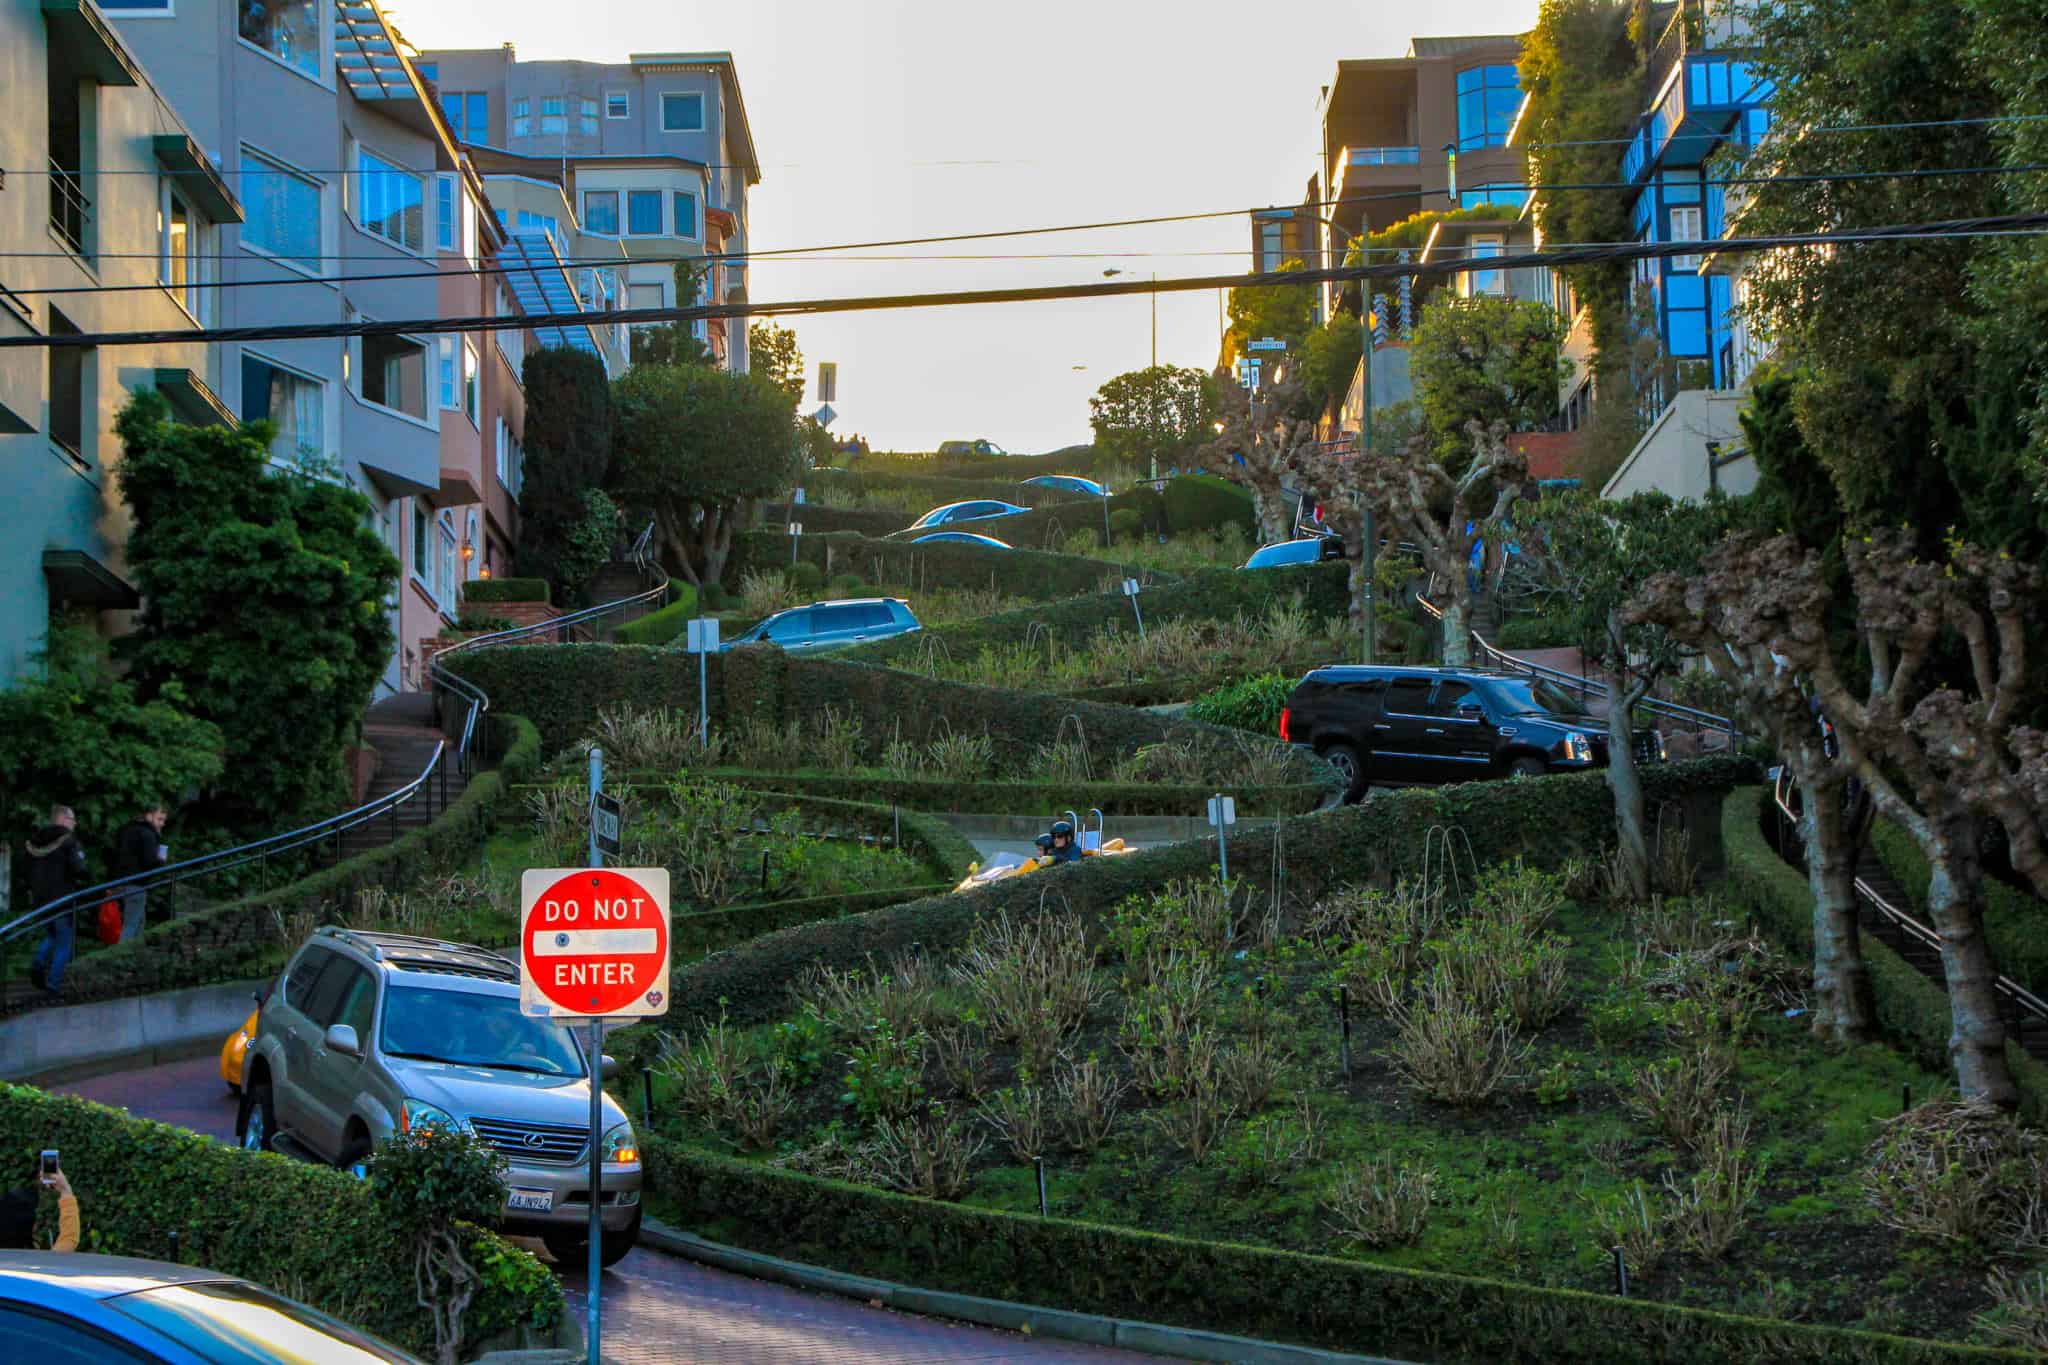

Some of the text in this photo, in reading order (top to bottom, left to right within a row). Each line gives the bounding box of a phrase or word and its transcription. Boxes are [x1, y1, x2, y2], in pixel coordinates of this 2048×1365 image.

[545, 899, 645, 922] DO NOT
[555, 963, 635, 986] ENTER
